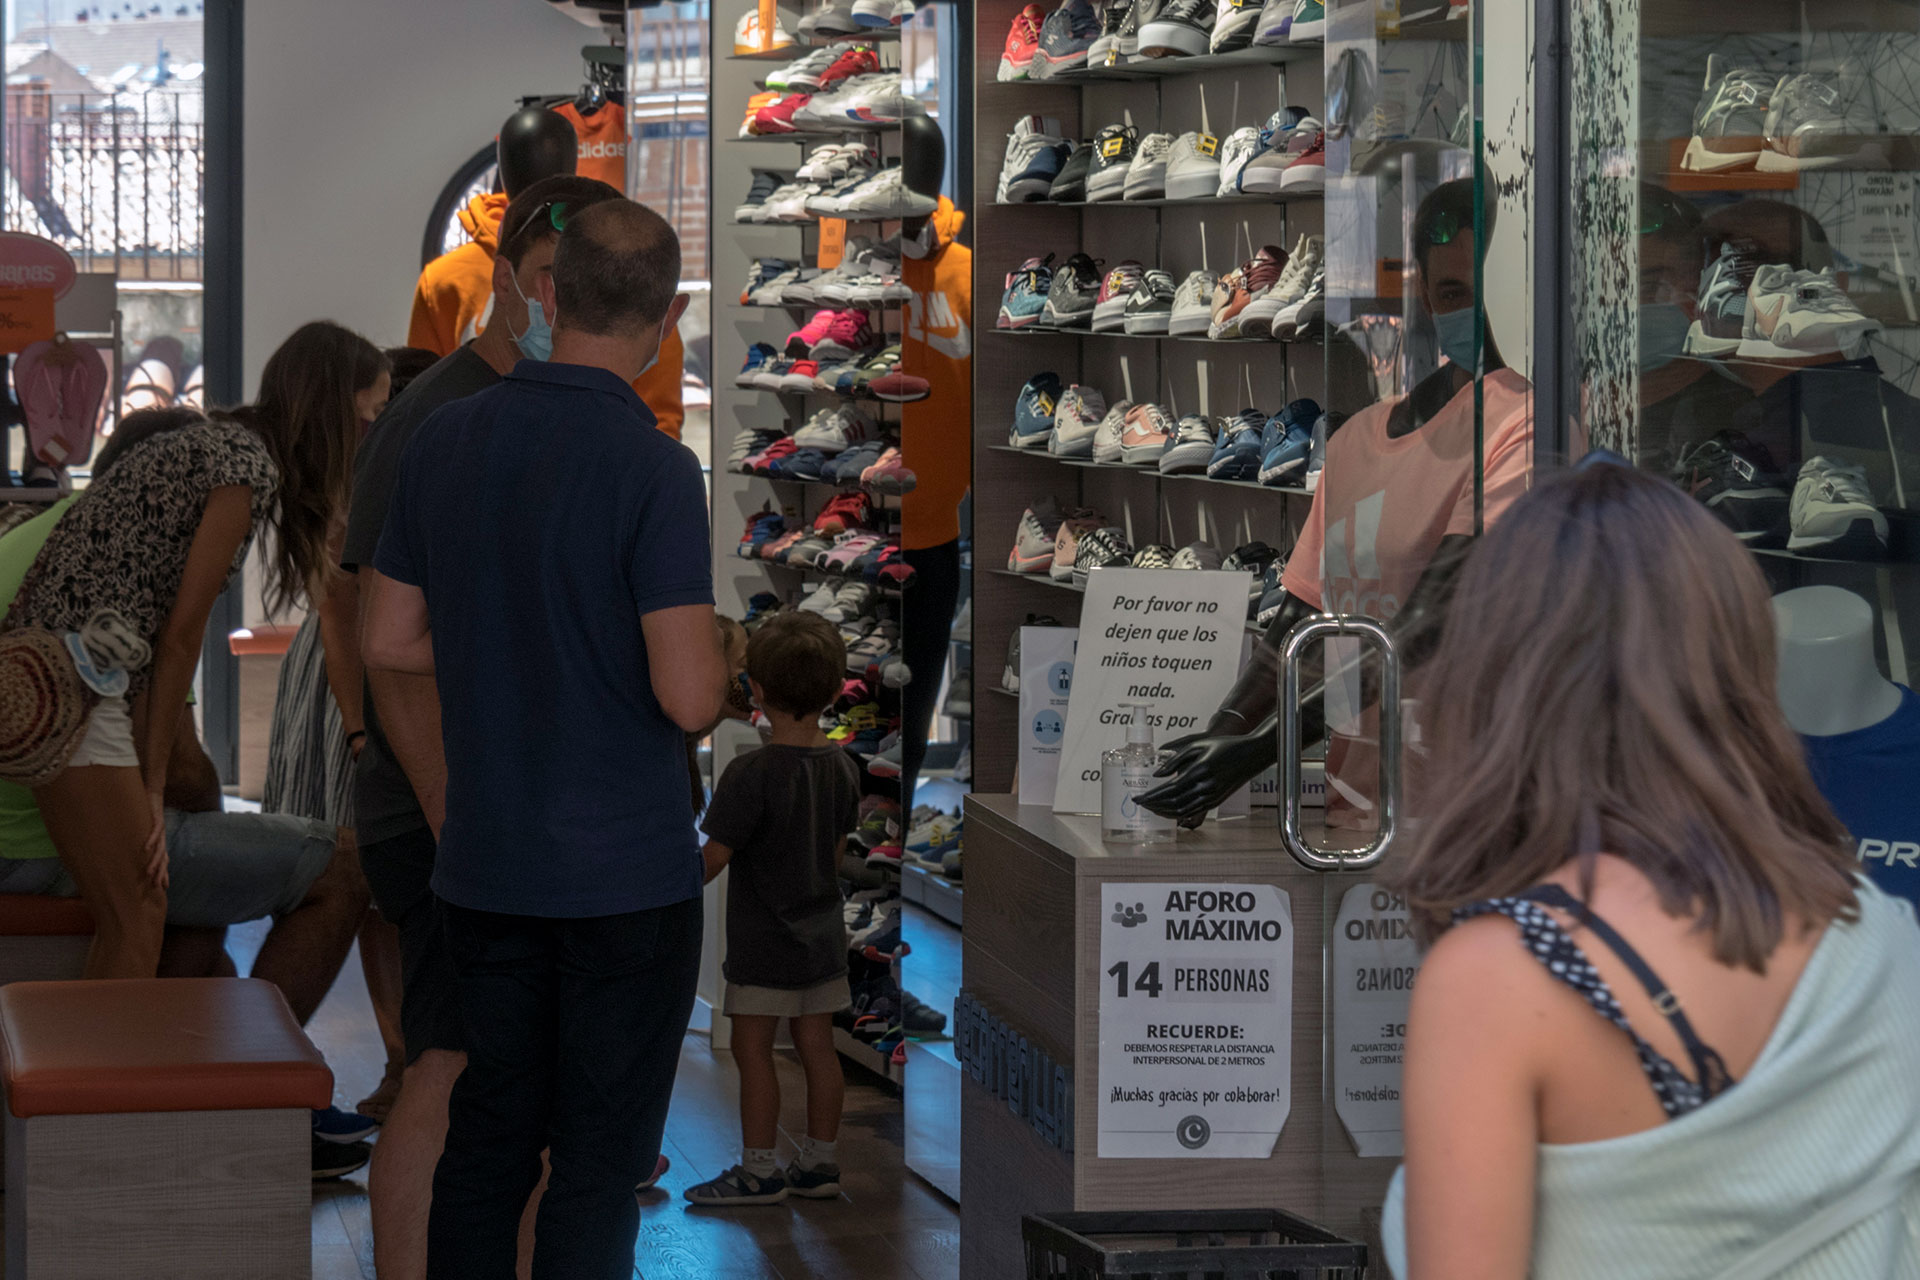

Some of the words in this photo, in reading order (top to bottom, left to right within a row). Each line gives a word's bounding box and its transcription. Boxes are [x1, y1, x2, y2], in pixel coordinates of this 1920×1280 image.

[577, 141, 625, 159] didas
[1112, 595, 1144, 611] Por
[1143, 595, 1193, 615] favor
[1195, 601, 1219, 614] no
[1105, 622, 1152, 643] dejen
[1156, 628, 1189, 644] que
[1192, 625, 1218, 642] los
[1100, 651, 1147, 669] niños
[1151, 654, 1213, 673] toquen
[1126, 682, 1175, 698] nada.
[1099, 709, 1163, 727] Graas
[1165, 715, 1198, 731] por
[1164, 891, 1256, 912] AFORO
[1165, 913, 1282, 941] MÁXIMO
[1107, 961, 1163, 998] 14
[1174, 968, 1270, 992] PERSONAS
[1146, 1024, 1245, 1039] RECUERDE:
[1123, 1043, 1168, 1053] DEBEMOS
[1168, 1043, 1213, 1053] RESPETAR
[1213, 1044, 1226, 1053] LA
[1226, 1044, 1275, 1054] DISTANCIA
[1132, 1056, 1207, 1065] INTERPERSONAL
[1207, 1057, 1220, 1065] DE
[1221, 1057, 1227, 1066] 2
[1228, 1057, 1265, 1066] METROS
[1110, 1086, 1154, 1104] ¡Muchas
[1158, 1087, 1199, 1107] gracias
[1203, 1090, 1220, 1107] por
[1224, 1086, 1280, 1103] colaborar!
